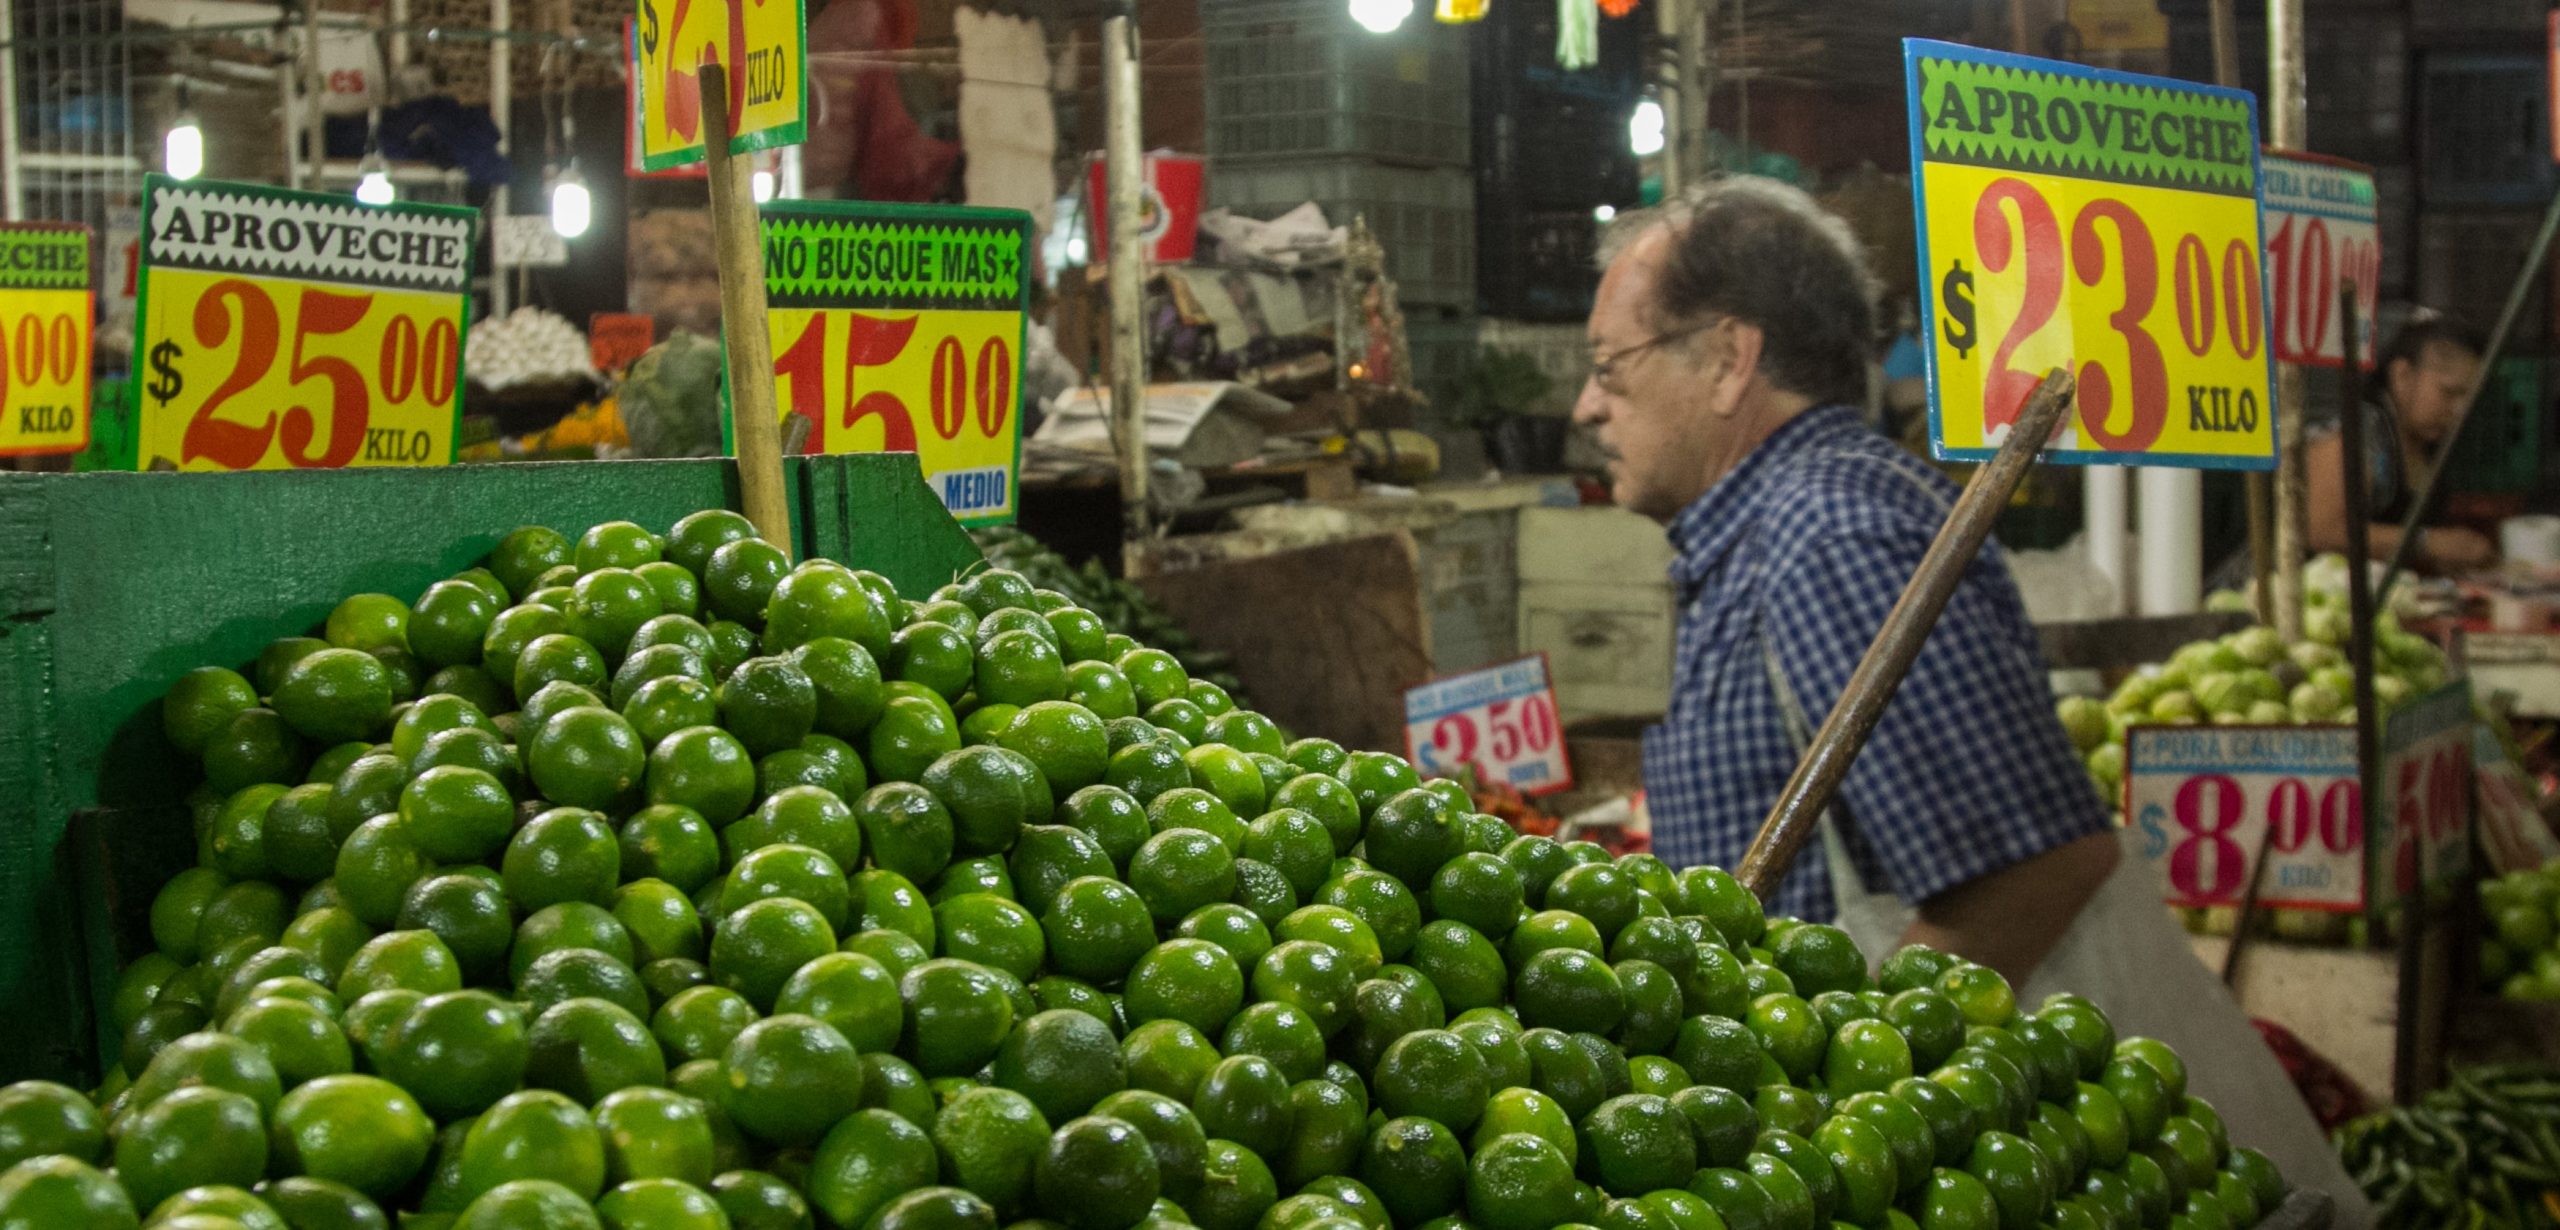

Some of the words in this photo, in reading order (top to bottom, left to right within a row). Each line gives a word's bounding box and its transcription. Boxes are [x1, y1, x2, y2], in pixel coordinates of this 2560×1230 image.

[747, 45, 785, 106] KILO
[1934, 81, 2246, 165] APROVECHE
[159, 206, 460, 269] APROVECHE
[765, 236, 807, 279] NO
[815, 237, 932, 284] BUSQUE
[941, 242, 998, 284] MAS
[1942, 259, 1976, 360] $
[2174, 232, 2261, 361] 00
[147, 338, 184, 407] $
[181, 278, 370, 470] 25
[379, 313, 460, 408] 00
[929, 334, 1011, 440] 00
[19, 403, 74, 434] KILO
[2187, 385, 2257, 433] KILO
[364, 428, 431, 462] KILO
[944, 469, 1006, 511] MEDIO
[2169, 772, 2246, 904] 8
